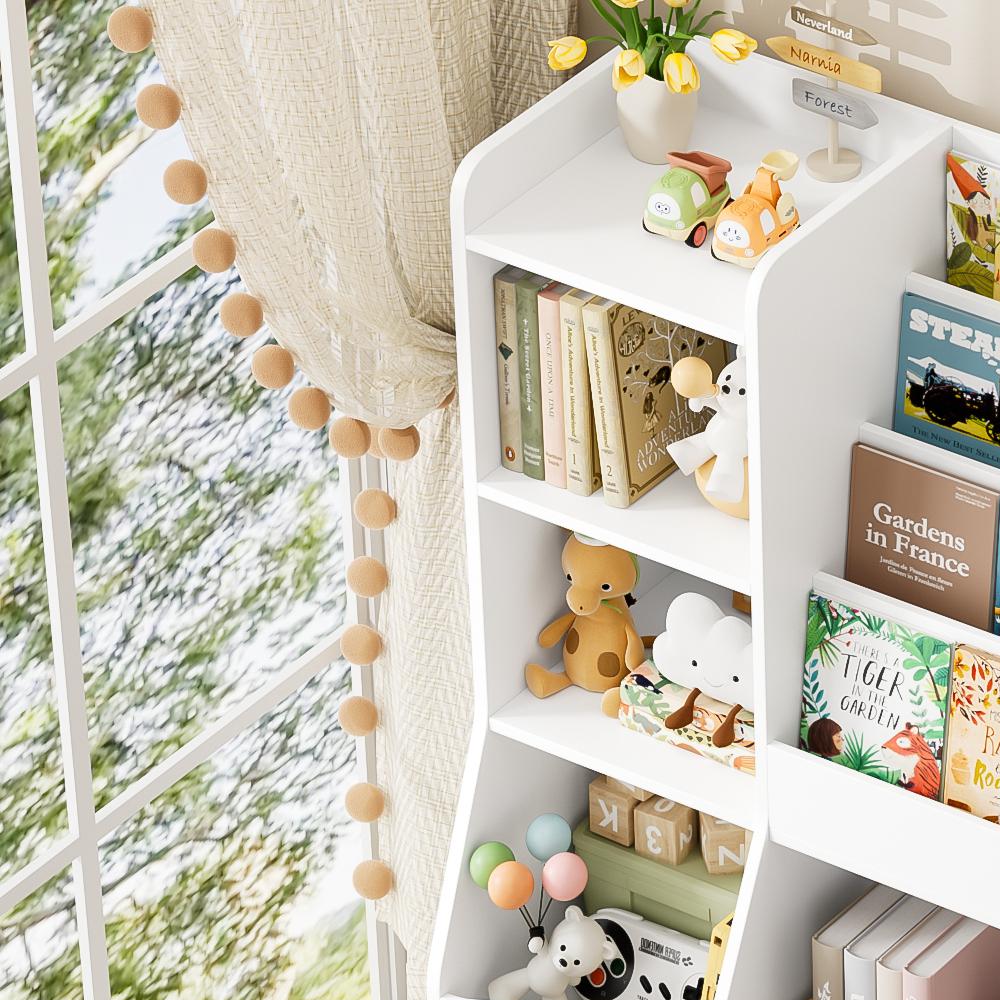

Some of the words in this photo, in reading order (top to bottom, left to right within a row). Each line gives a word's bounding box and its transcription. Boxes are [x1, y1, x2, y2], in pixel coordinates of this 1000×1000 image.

[796, 11, 854, 41] Neverland
[790, 46, 842, 75] Narnia
[804, 91, 853, 118] Forest
[606, 464, 613, 477] 2
[873, 502, 966, 552] Gardens
[865, 522, 887, 549] in
[893, 532, 970, 577] France
[841, 653, 904, 701] TIGER
[840, 695, 900, 730] GARDEN
